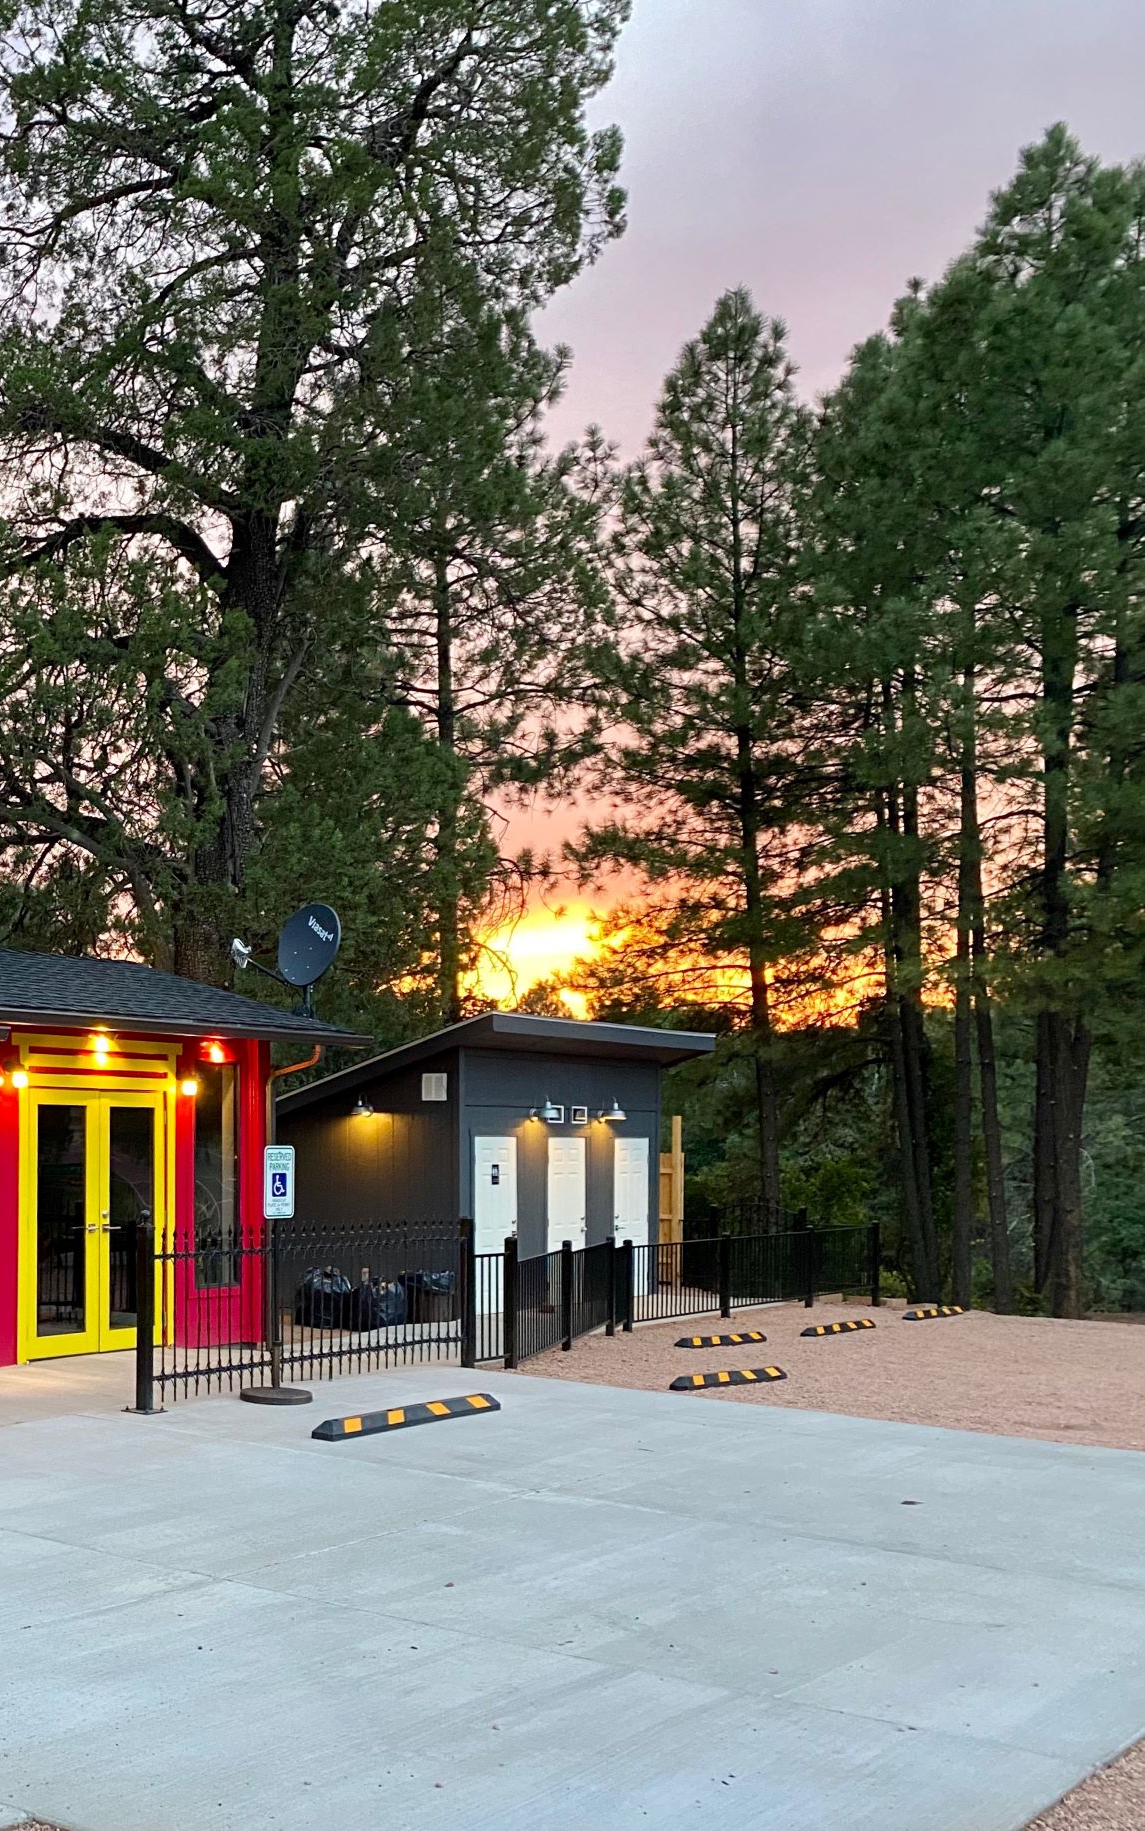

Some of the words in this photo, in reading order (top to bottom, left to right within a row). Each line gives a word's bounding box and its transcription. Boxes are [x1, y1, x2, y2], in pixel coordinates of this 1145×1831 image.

[308, 915, 329, 942] Viasat
[267, 1152, 292, 1161] RESERVED
[269, 1162, 290, 1171] PARKING
